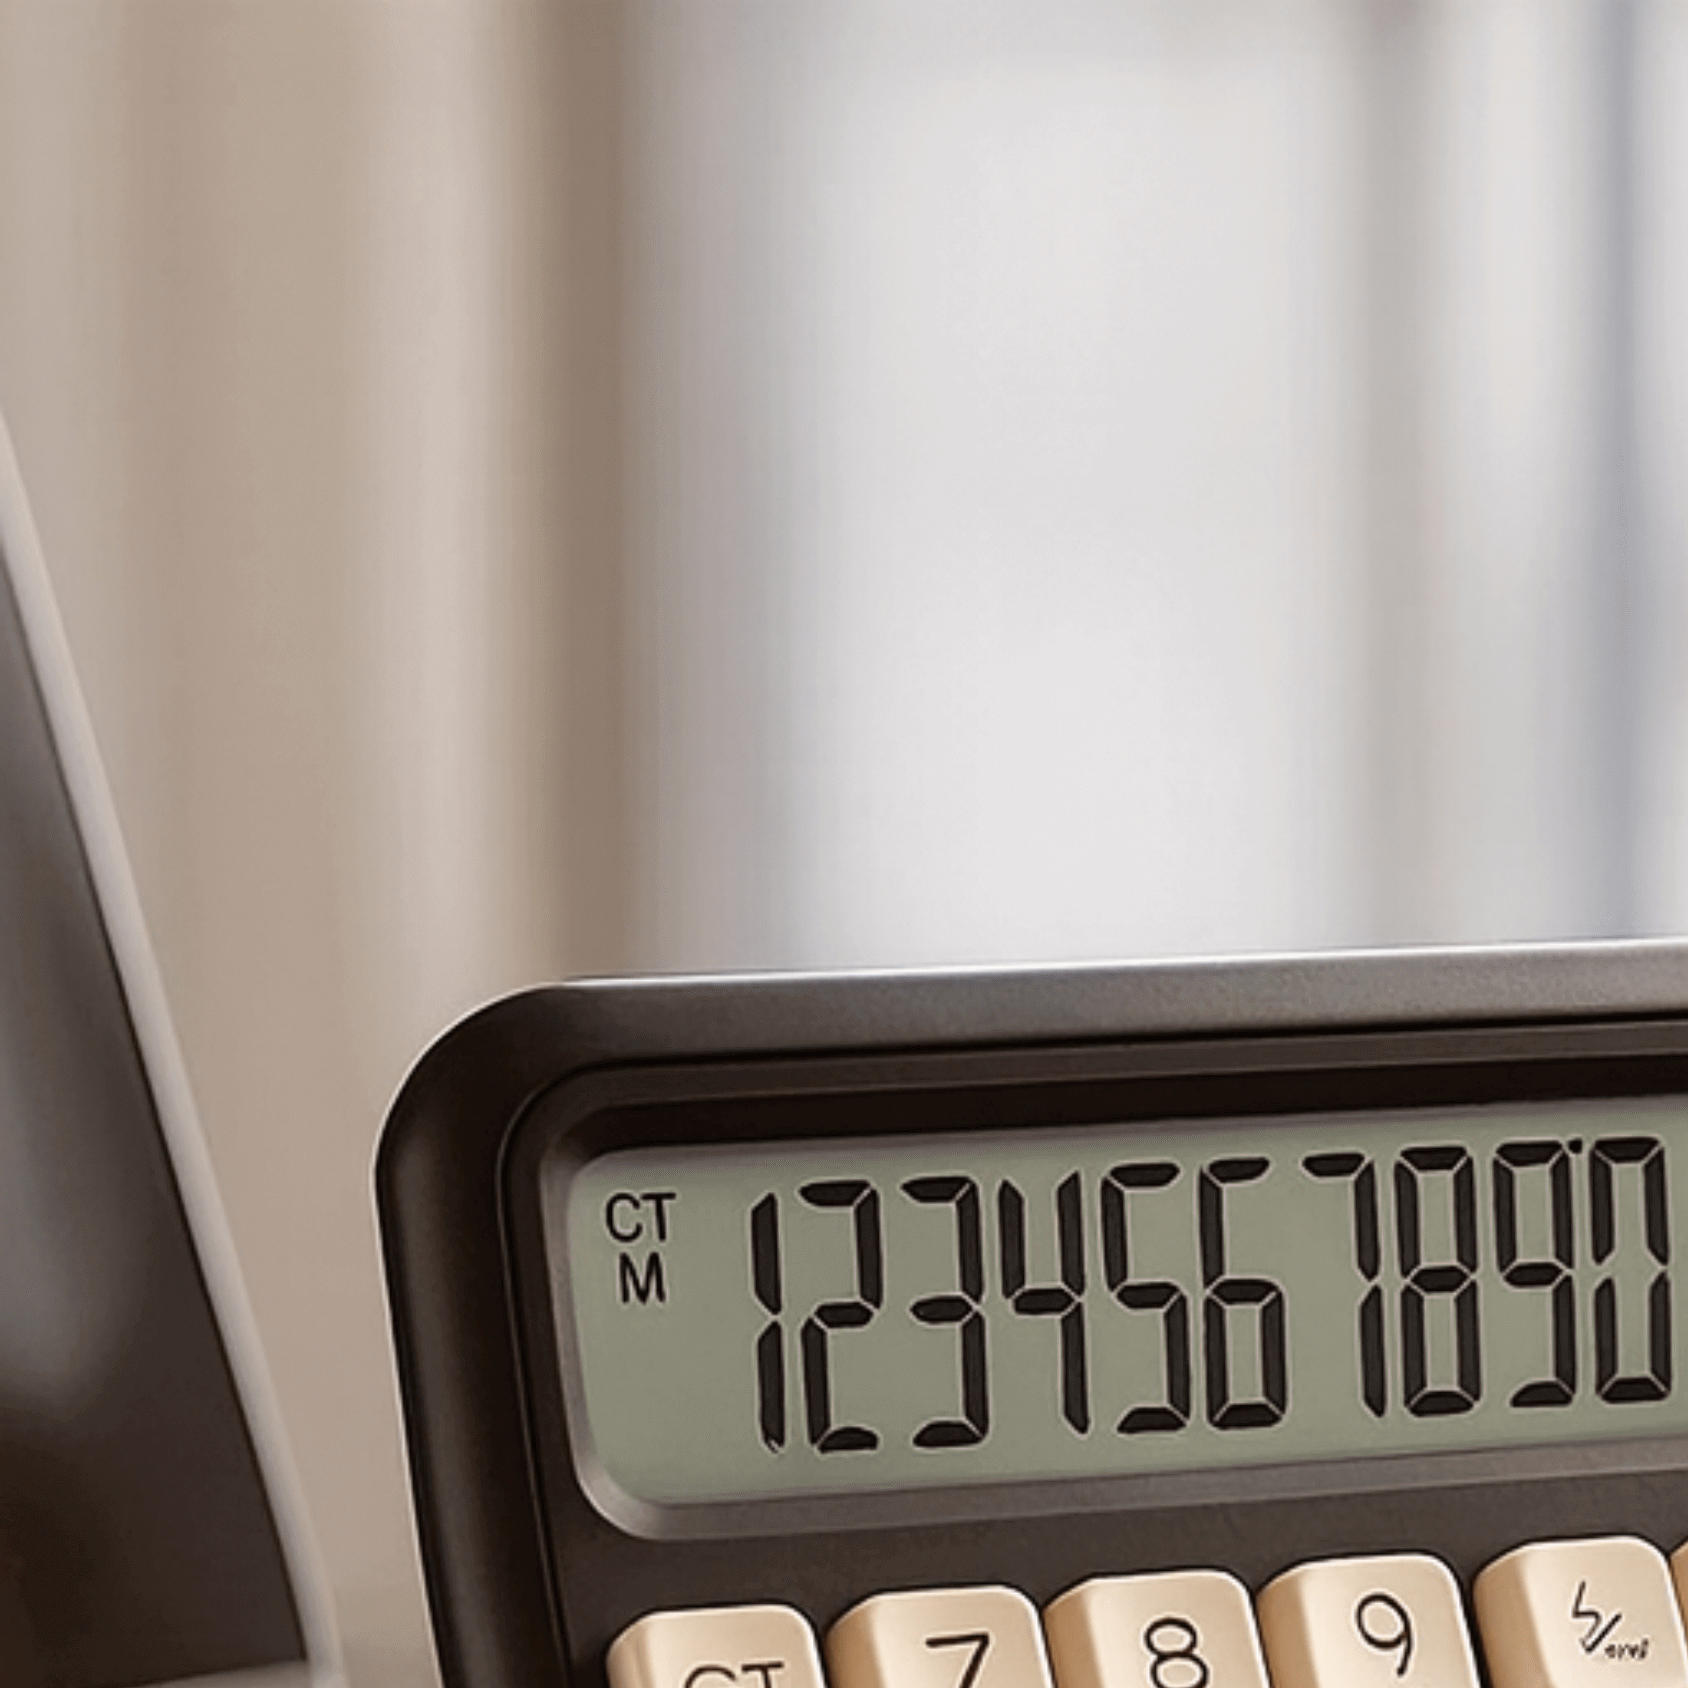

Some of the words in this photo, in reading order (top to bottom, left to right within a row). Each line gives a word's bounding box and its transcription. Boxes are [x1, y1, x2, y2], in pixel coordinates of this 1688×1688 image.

[604, 1192, 677, 1245] CT
[620, 1253, 665, 1304] M
[1356, 1593, 1413, 1676] 9
